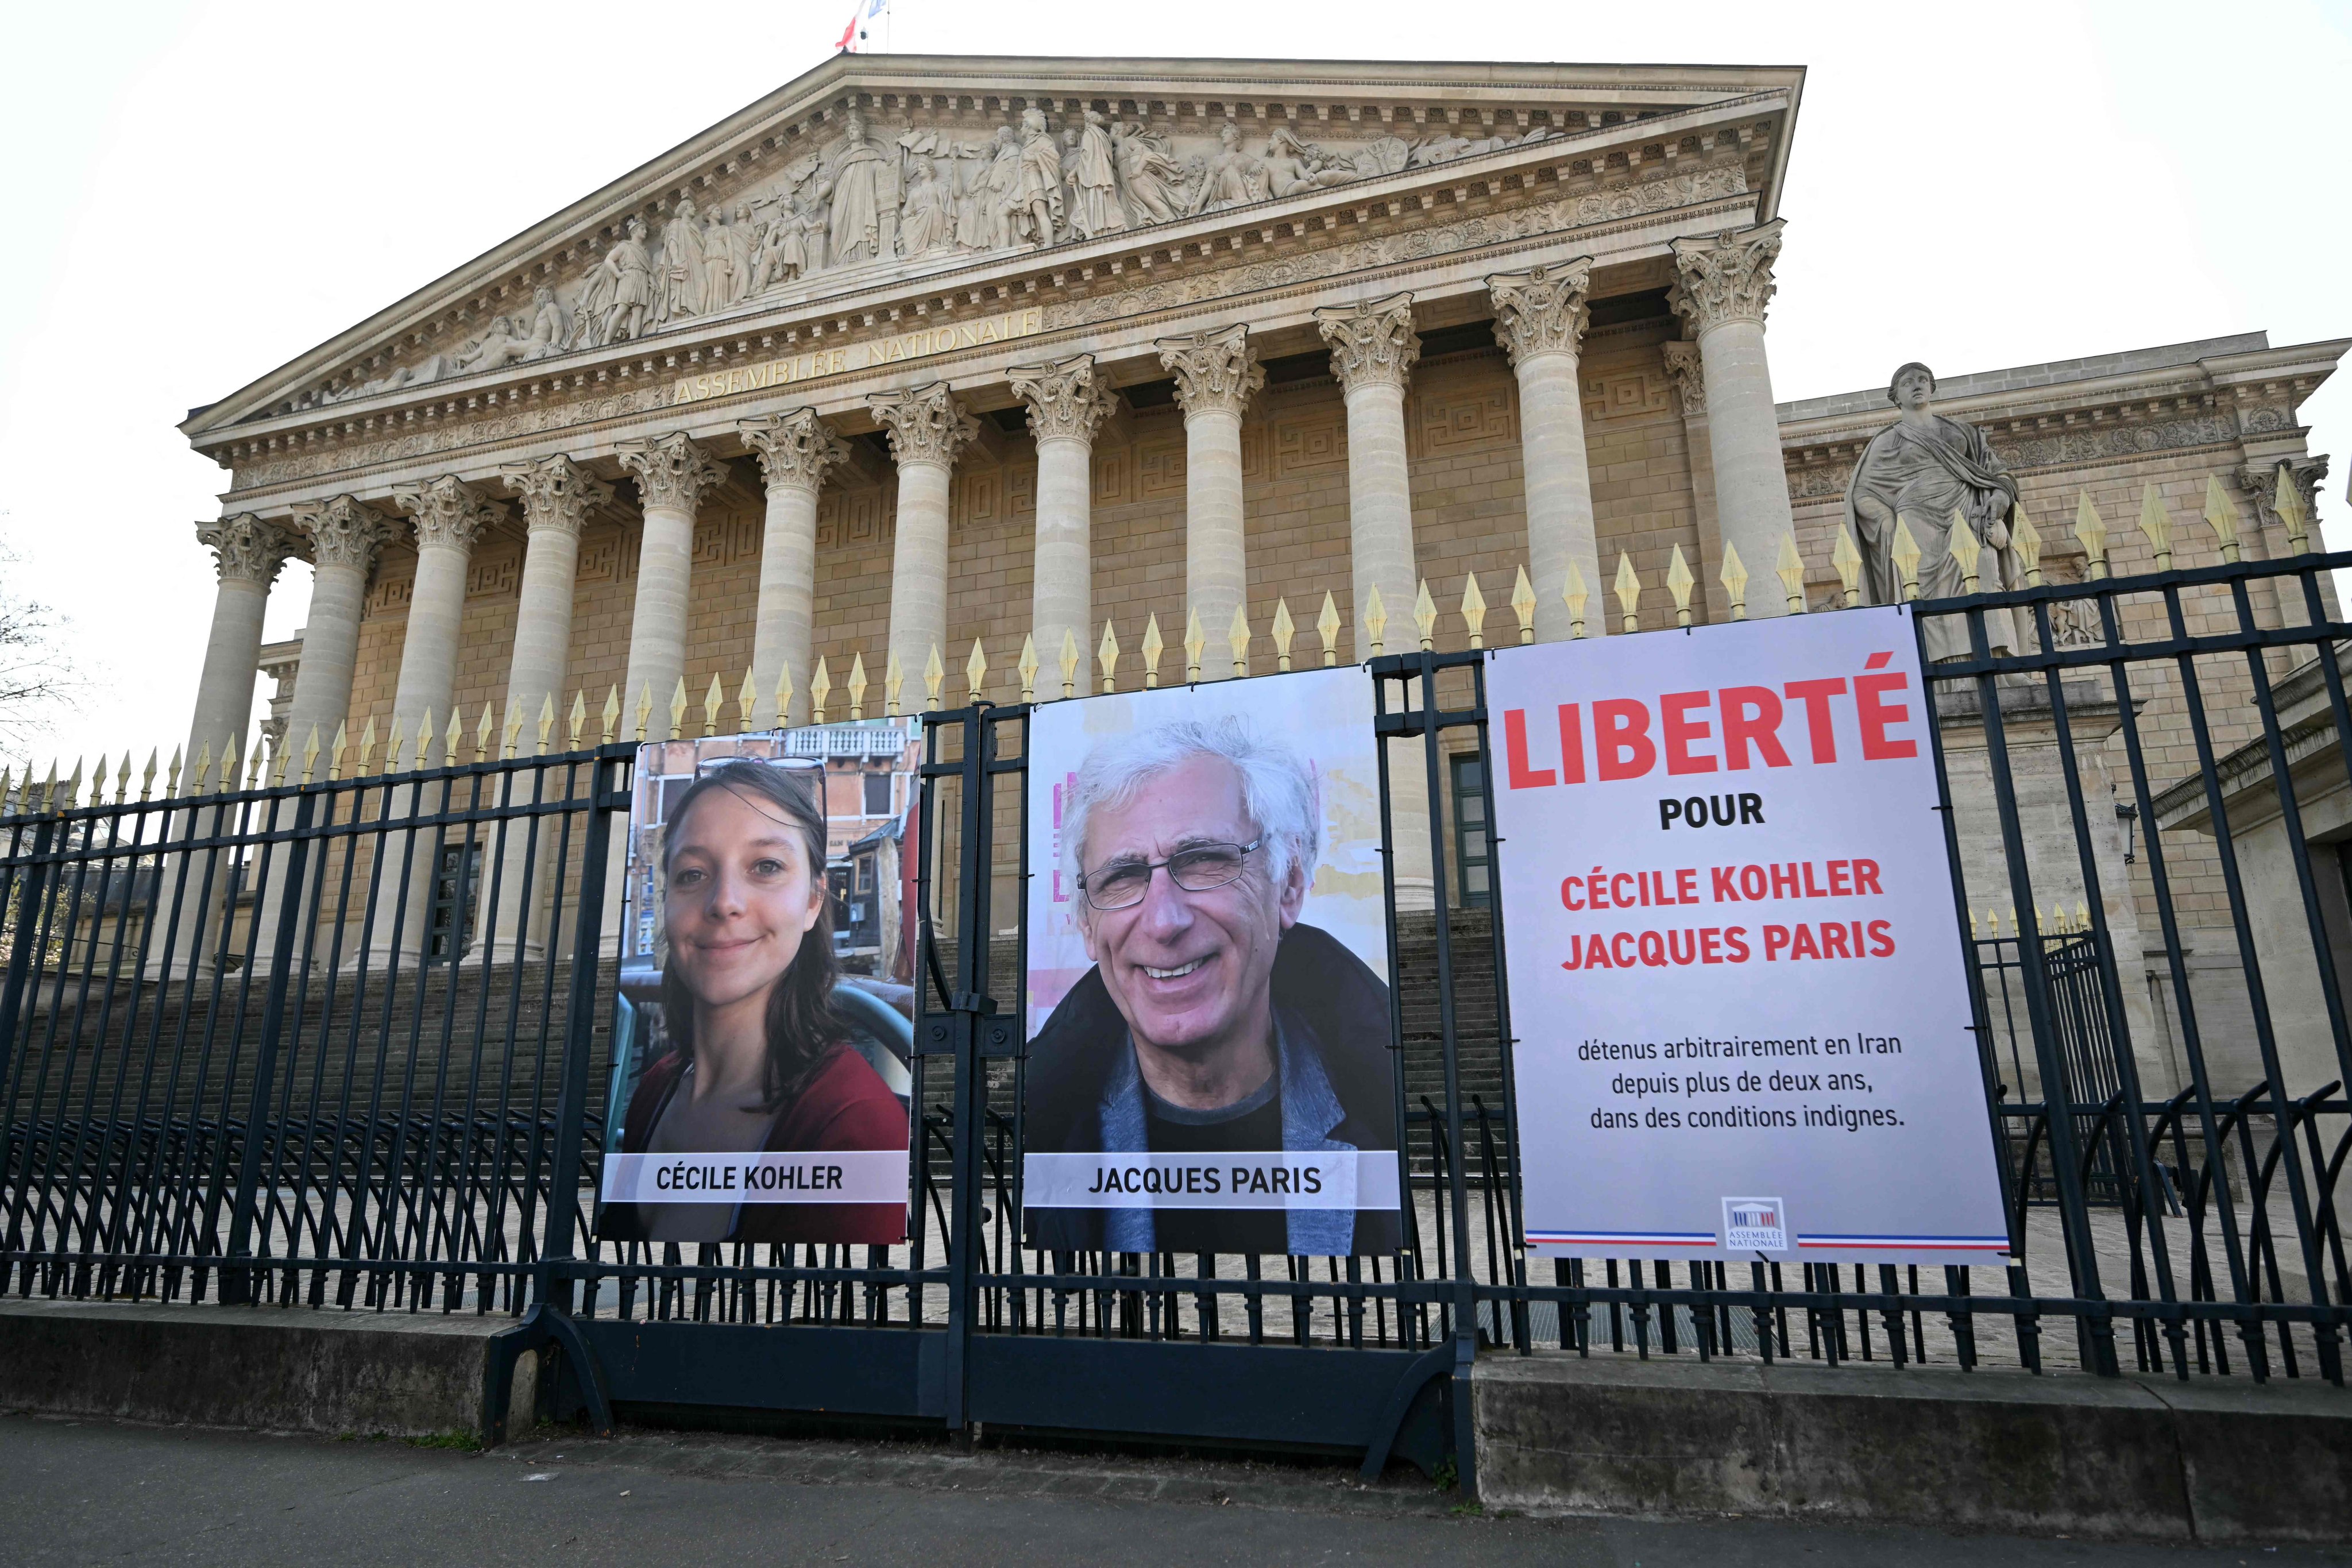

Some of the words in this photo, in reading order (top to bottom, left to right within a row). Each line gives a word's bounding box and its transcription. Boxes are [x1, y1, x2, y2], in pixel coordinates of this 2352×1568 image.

[675, 350, 845, 403] ASSEMBLÉE
[867, 310, 1040, 366] NATIONALE
[1504, 651, 1918, 790] LIBERTÉ
[1659, 793, 1766, 831] POUR
[1561, 866, 1700, 912] CÉCILE
[1711, 859, 1884, 903] KOHLER
[1561, 926, 1750, 971] JACQUES
[1763, 920, 1896, 961] PARIS
[1578, 1038, 1658, 1061] détenus
[1664, 1036, 1819, 1059] arbitrairement
[1825, 1038, 1851, 1056] en
[1857, 1032, 1902, 1055] Iran
[1612, 1072, 1679, 1099] depuis
[1686, 1071, 1730, 1098] plus
[1737, 1069, 1762, 1092] de
[1769, 1069, 1822, 1092] deux
[1828, 1072, 1873, 1094] ans,
[1590, 1107, 1639, 1129] dans
[1645, 1106, 1681, 1129] des
[1687, 1104, 1797, 1128] conditions
[1803, 1103, 1905, 1132] indignes.
[656, 1161, 736, 1190] CÉCILE
[744, 1165, 843, 1190] KOHLER
[1088, 1167, 1221, 1194] JACQUES
[1231, 1167, 1322, 1194] PARIS
[1729, 1230, 1783, 1239] ASSEMBLÉE
[1729, 1239, 1784, 1248] NATIONALE
